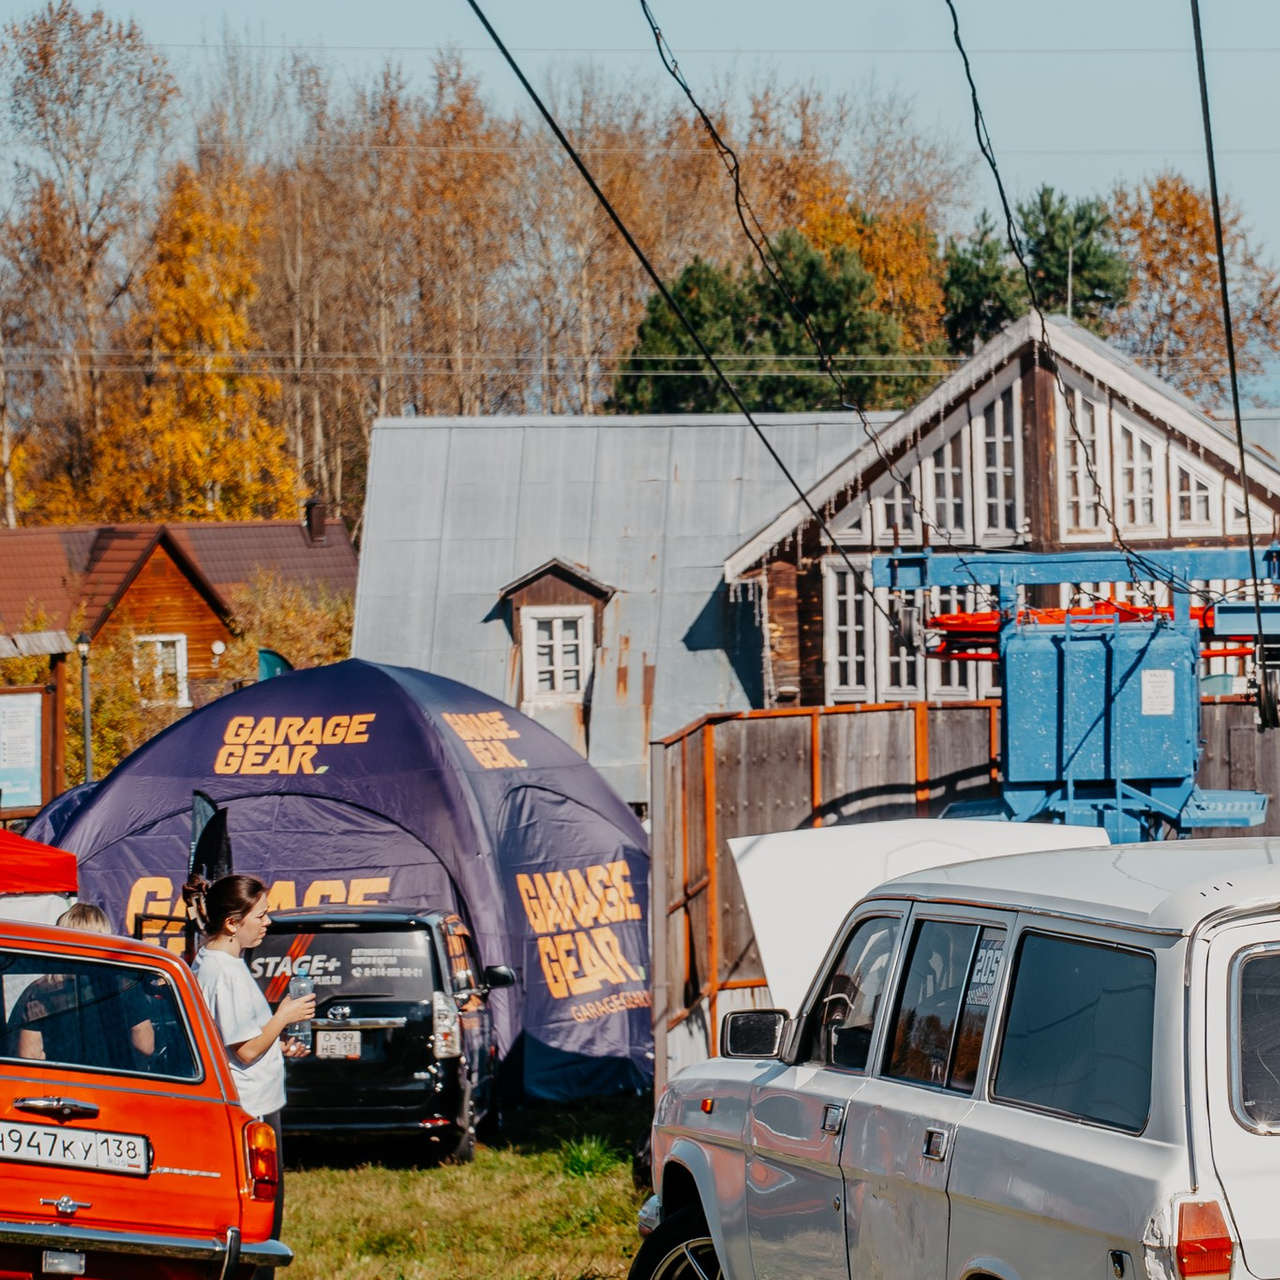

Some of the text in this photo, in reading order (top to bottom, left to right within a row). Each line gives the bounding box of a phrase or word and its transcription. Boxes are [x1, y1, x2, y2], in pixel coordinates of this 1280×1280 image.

[223, 712, 377, 745] GARAGE
[441, 711, 521, 741] GARAGE
[516, 860, 642, 933] GARAGE
[251, 955, 341, 978] STAGE+
[972, 949, 1002, 984] 205
[100, 1138, 138, 1159] 138
[107, 1157, 127, 1167] RUS
